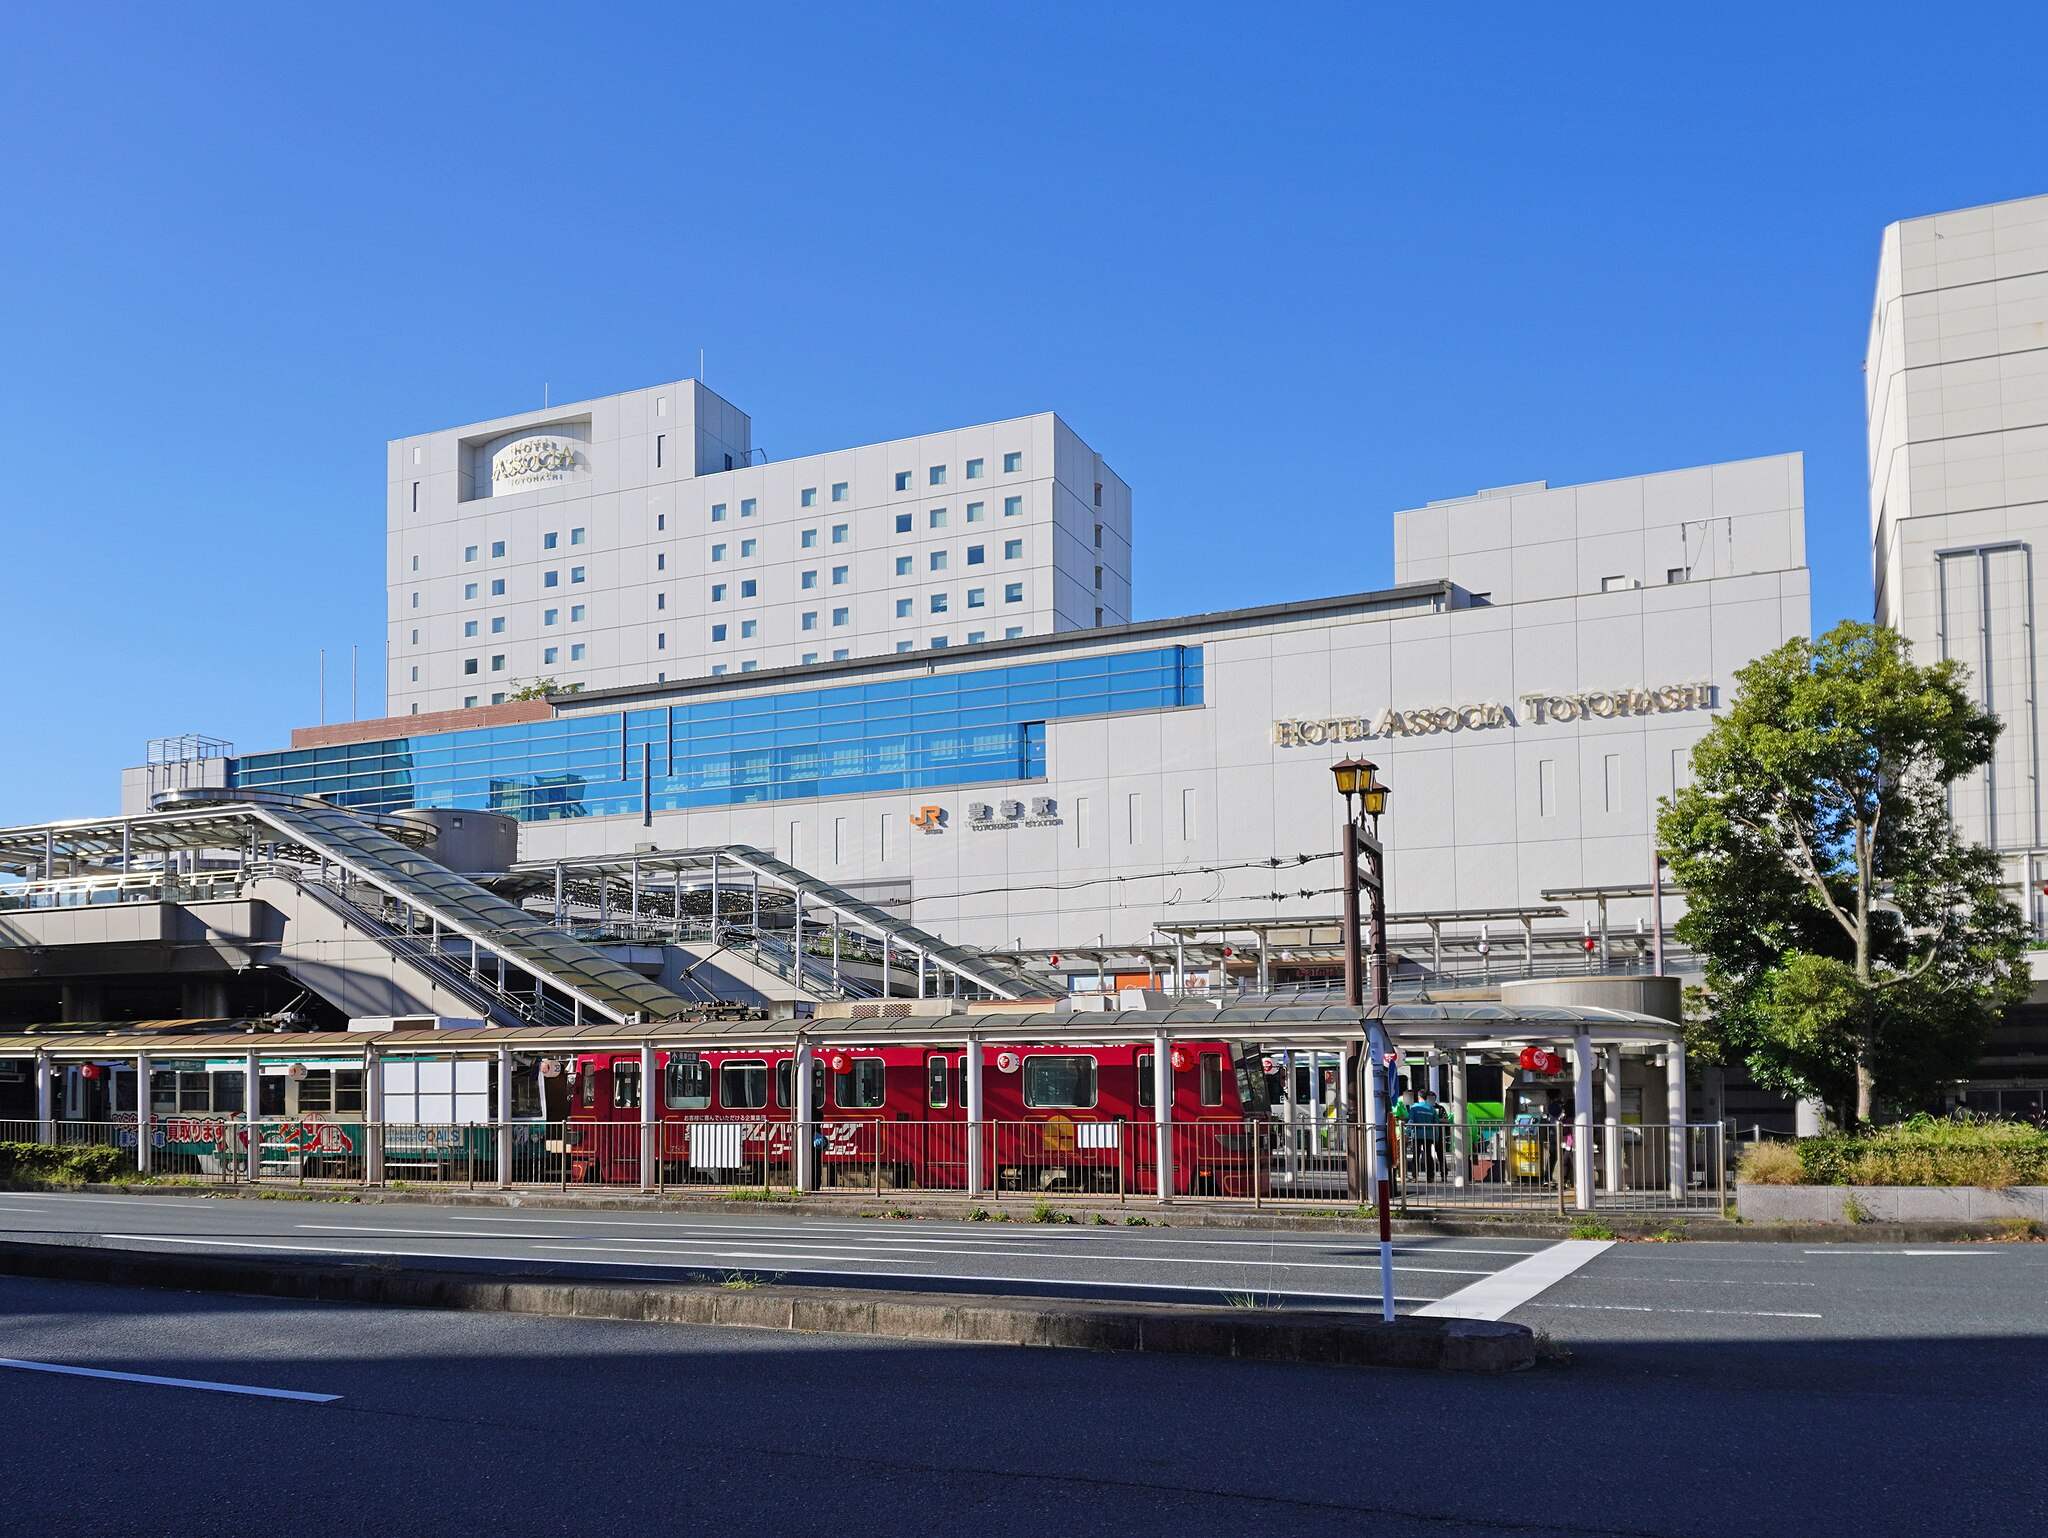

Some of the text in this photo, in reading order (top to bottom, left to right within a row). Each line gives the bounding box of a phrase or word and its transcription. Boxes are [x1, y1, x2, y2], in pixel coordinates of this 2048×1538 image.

[511, 439, 557, 455] HOTEL
[510, 473, 563, 486] TOYOHASHI
[1273, 681, 1714, 746] HOTEL ASSOCIA TOYOHASHI
[910, 805, 942, 826] JR
[968, 797, 1052, 820] 豊橋駅
[418, 1129, 460, 1143] GOALS
